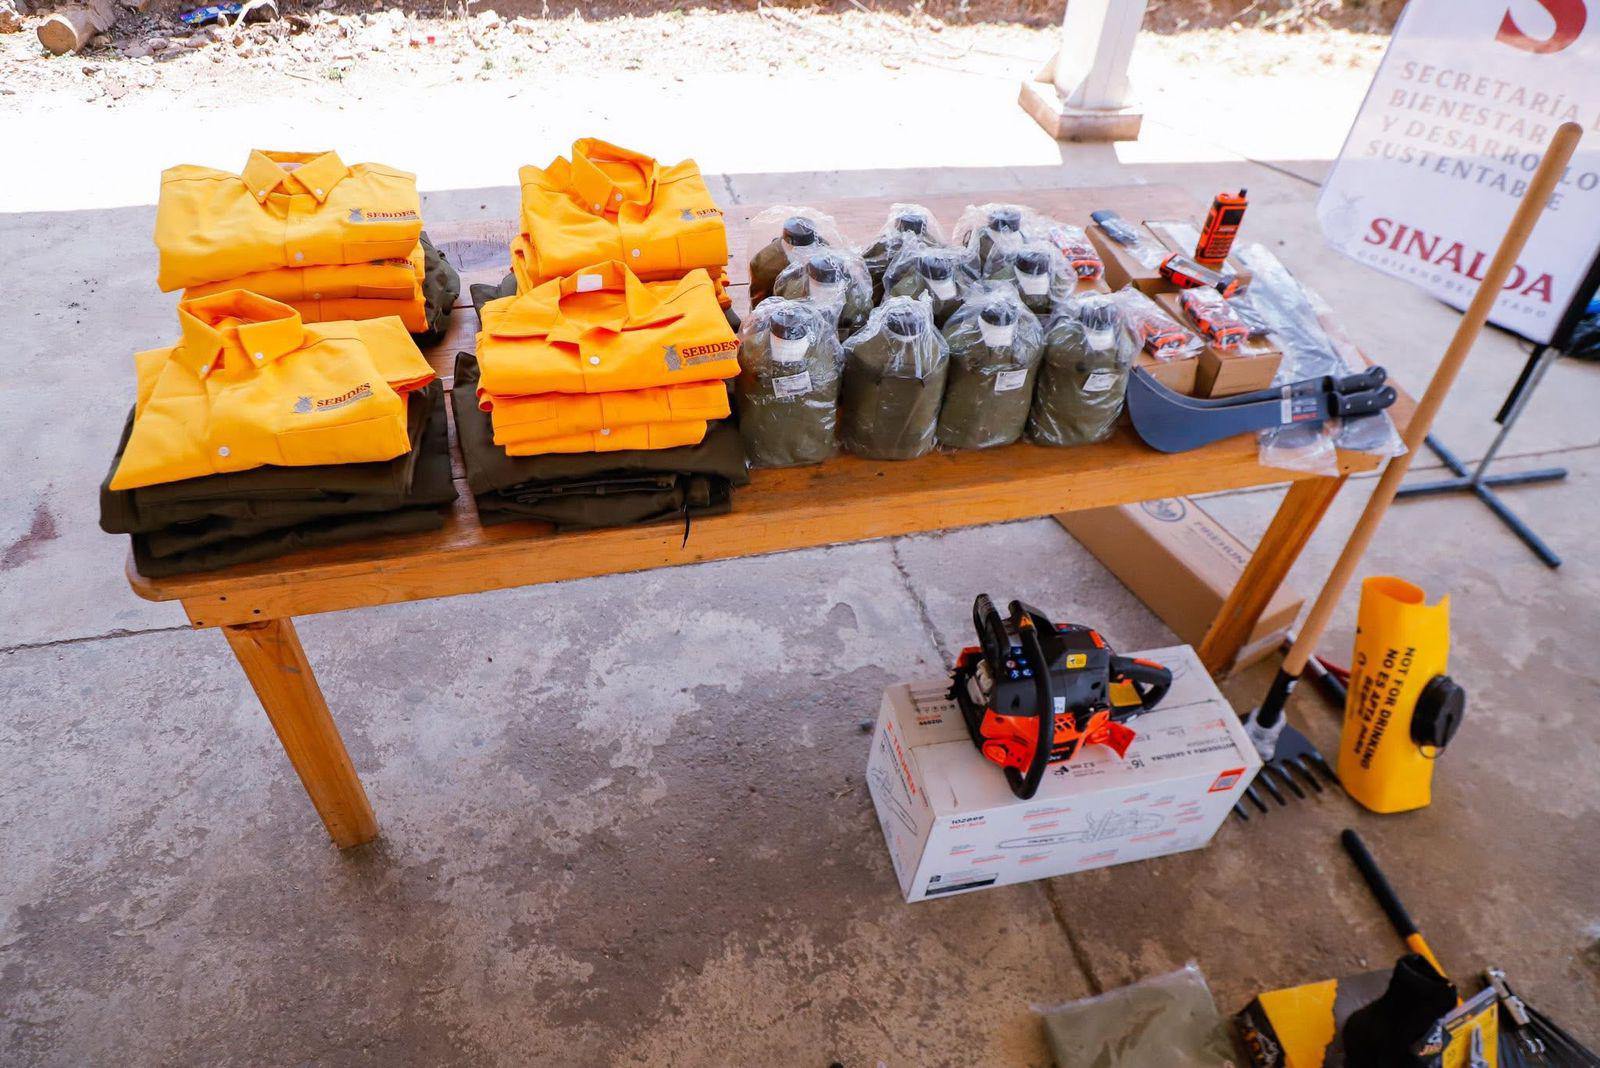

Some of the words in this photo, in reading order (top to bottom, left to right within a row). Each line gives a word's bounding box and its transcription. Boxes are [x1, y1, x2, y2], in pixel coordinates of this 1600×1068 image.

[1400, 61, 1580, 121] SECRETARÍA
[1389, 88, 1549, 145] BIENESTAR
[1382, 114, 1399, 133] Y
[1404, 119, 1600, 192] DESARROLO
[1366, 139, 1564, 212] SUSTENTABE
[682, 339, 736, 358] SEBIDES
[317, 382, 371, 407] SEBIDES
[1383, 648, 1399, 669] NO
[1398, 647, 1416, 676] NOT
[1376, 671, 1390, 689] ES
[1385, 679, 1404, 706] FOR
[1363, 691, 1381, 723] APTA
[1361, 709, 1392, 770] DRINKING
